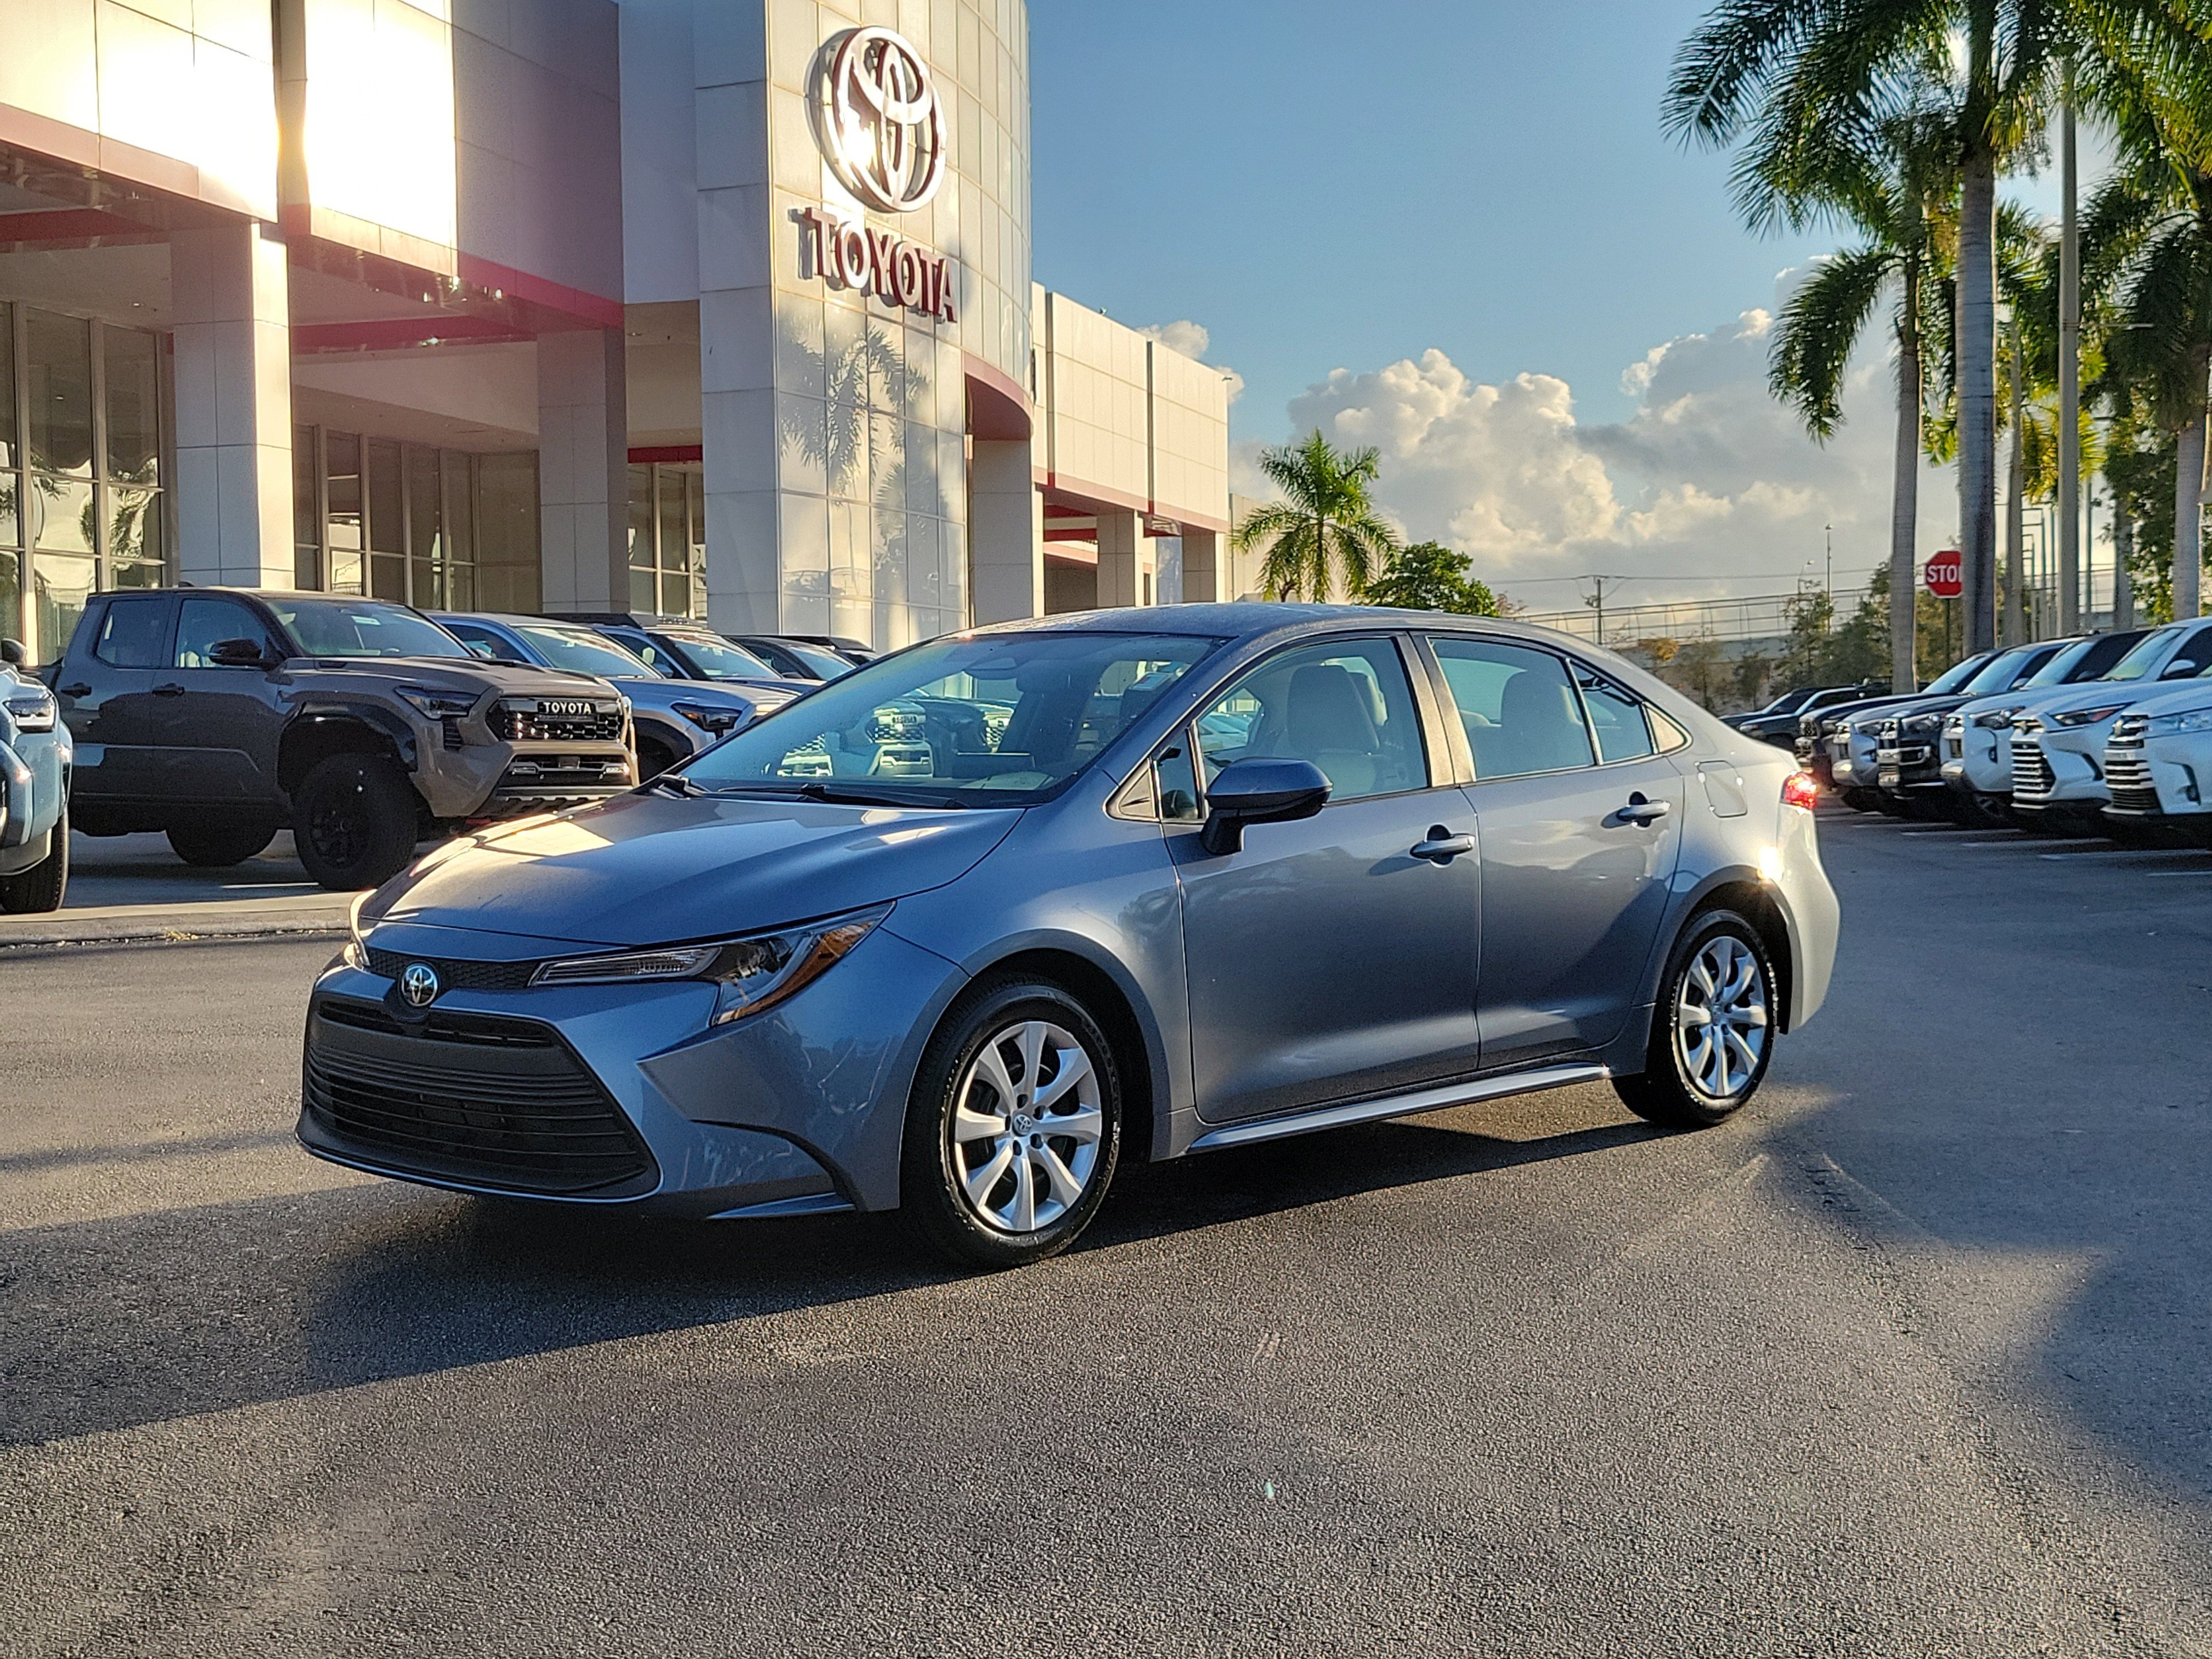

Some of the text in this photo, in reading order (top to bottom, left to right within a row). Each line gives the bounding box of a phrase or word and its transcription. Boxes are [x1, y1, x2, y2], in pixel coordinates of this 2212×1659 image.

[804, 207, 958, 324] TOYOTA
[1927, 565, 1962, 583] STO
[543, 702, 592, 714] TOYOTA
